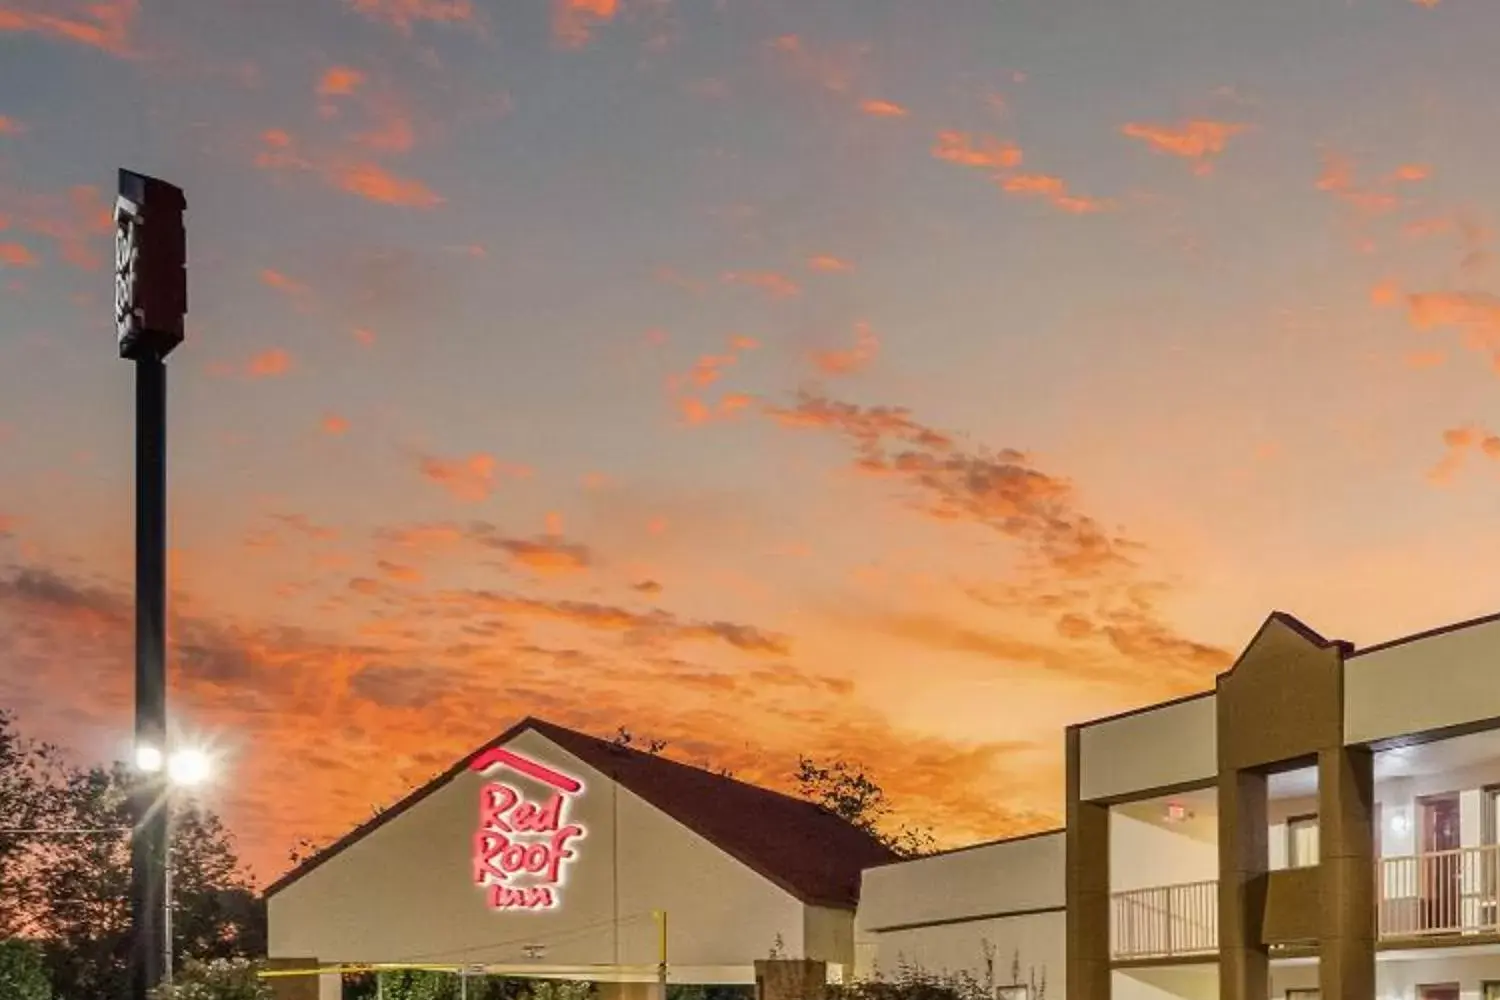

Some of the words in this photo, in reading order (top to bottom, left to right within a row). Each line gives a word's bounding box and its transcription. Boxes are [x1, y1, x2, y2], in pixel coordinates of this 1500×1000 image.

[480, 783, 563, 832] Red
[474, 827, 582, 883] Roof
[488, 885, 554, 908] Inn
